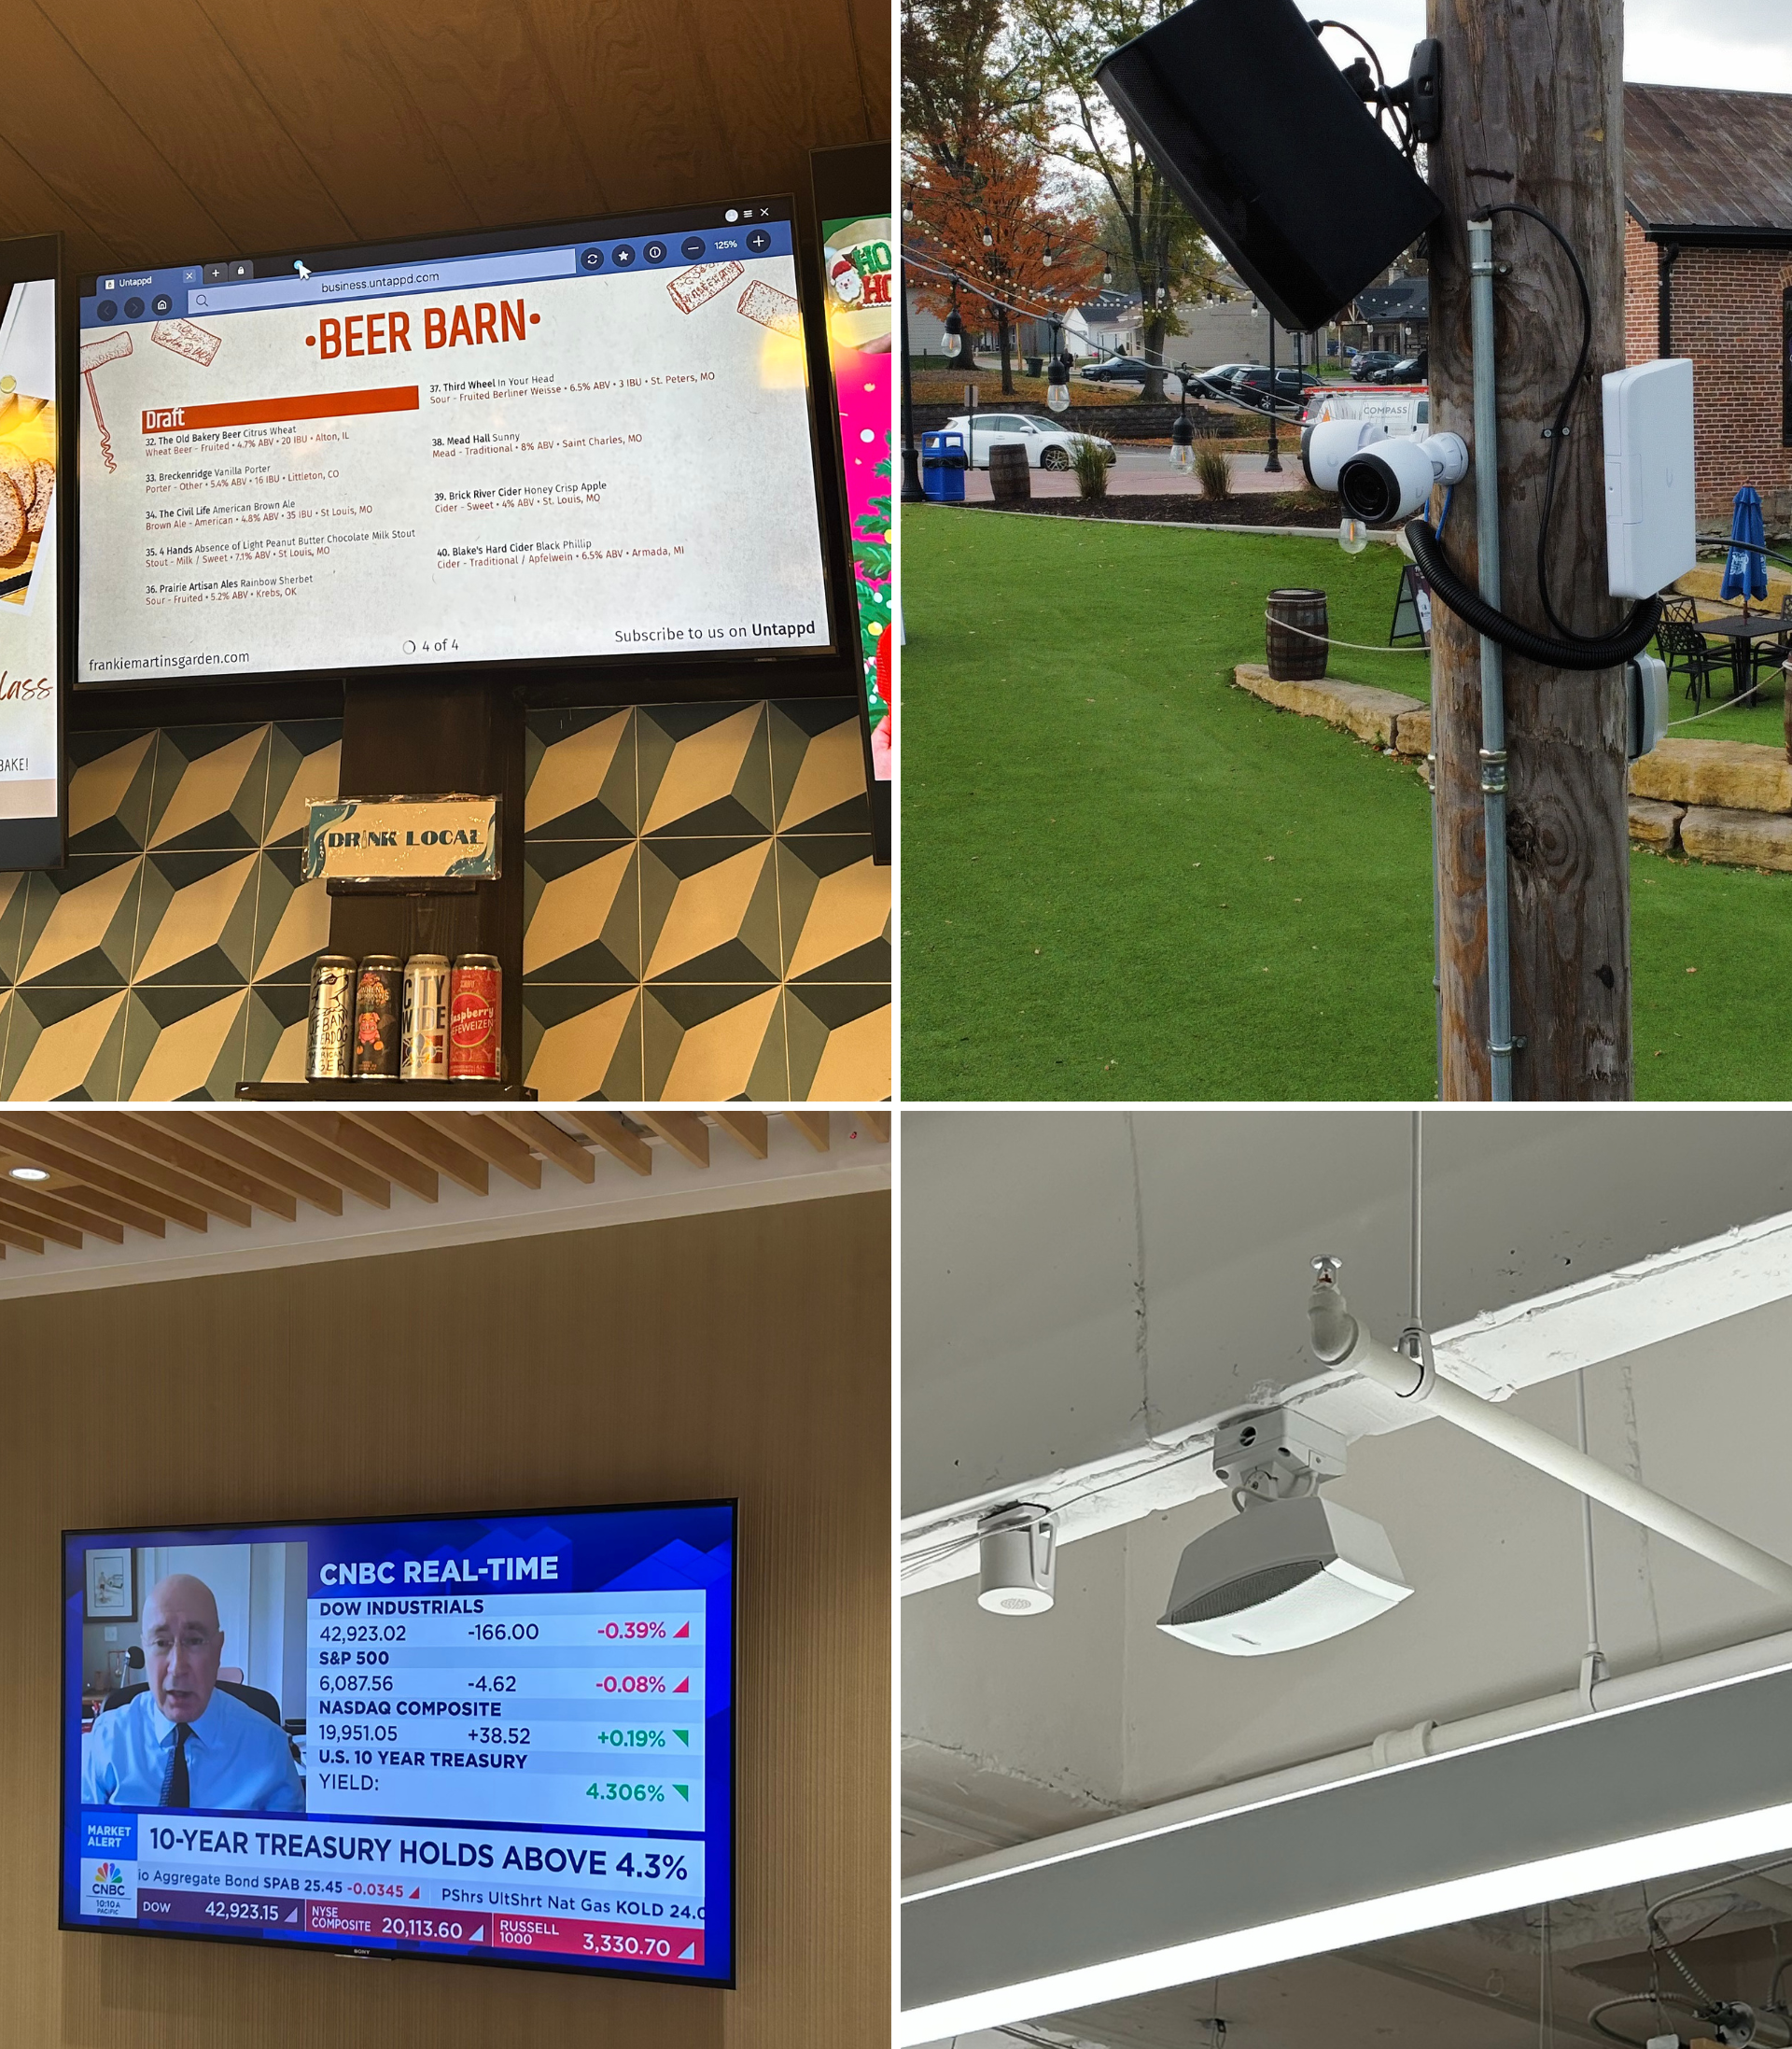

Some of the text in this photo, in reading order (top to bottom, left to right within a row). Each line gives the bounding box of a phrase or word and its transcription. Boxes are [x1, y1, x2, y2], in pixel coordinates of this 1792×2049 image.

[714, 238, 737, 251] 125%
[119, 275, 152, 288] Untappd
[321, 272, 440, 295] business.untappd.com
[320, 299, 525, 360] BEER BARN
[428, 373, 554, 393] 37. Third Wheel In Your Head
[146, 407, 186, 429] Draft
[1364, 406, 1407, 415] COMPASS
[144, 425, 297, 446] 32. The Old Bakery Beer Citrus Wheat
[431, 432, 520, 447] 38. Mead Hall Sunny
[432, 433, 642, 458] Mead Traditional 8% ABV Saint Charles, MO
[433, 480, 607, 501] 39. Brick River Cider Honey Crisp Apple
[434, 492, 600, 513] Cider Sweet 4% ABV St. Louis, MO
[436, 539, 592, 557] 40. Blake's Hard Cider Black Phillip
[436, 545, 684, 569] Cider Traditional Apfelwein 6.5% ABV Armada, MI
[146, 574, 314, 595] 36. Prairie Artisan Ales Rainbow Sherbet
[145, 586, 297, 606] Sour Fruited 5.2% ABV Krebs, OK
[615, 621, 815, 643] Subscribe to us on Untappd
[422, 639, 459, 653] 4 of 4
[89, 651, 250, 671] frankiemartinsgarden.com
[406, 829, 484, 846] LOCAL
[404, 975, 445, 1010] CTY
[452, 1018, 494, 1035] EFEWEIZEN
[320, 1555, 559, 1586] CNBC REAL-TIME
[320, 1598, 484, 1617] DOW INDUSTRIALS
[319, 1621, 666, 1645] 42,923.02 -166.00 -0.39%
[319, 1650, 390, 1666] S&P 500
[319, 1675, 665, 1694] 6,087.56 -4.62 -0.08%
[319, 1700, 502, 1717] NASDAQ COMPOSITE
[318, 1724, 665, 1747] 19,951.05 +38.52 +0.19%
[319, 1749, 528, 1770] U.S. 10 YEAR TREASURY
[318, 1774, 665, 1803] YIELD: 4.306%
[88, 1824, 132, 1837] MARKET
[88, 1835, 122, 1848] ALERT
[150, 1827, 688, 1881] 10-YEAR TREASURY HOLDS ABOVE 4.3%
[91, 1884, 125, 1897] CNBC
[153, 1870, 221, 1889] Aggregate
[225, 1874, 259, 1888] Bond
[263, 1876, 301, 1891] SPAB
[304, 1878, 343, 1894] 25.45
[346, 1882, 404, 1898] -0.0345
[441, 1888, 483, 1904] PShrs
[488, 1890, 542, 1909] UltShrt
[547, 1895, 576, 1911] Nat
[581, 1898, 610, 1914] Gas
[616, 1901, 664, 1916] KOLD
[95, 1899, 121, 1910] 10:10A
[96, 1907, 119, 1916] PACIFIC
[143, 1901, 279, 1922] DOW 42,923.15
[312, 1905, 339, 1918] NYSE
[312, 1917, 371, 1932] COMPOSITE
[382, 1916, 463, 1939] 20,113.60
[499, 1919, 560, 1936] RUSSELL
[499, 1931, 533, 1945] 1000
[582, 1932, 671, 1958] 3,330.70
